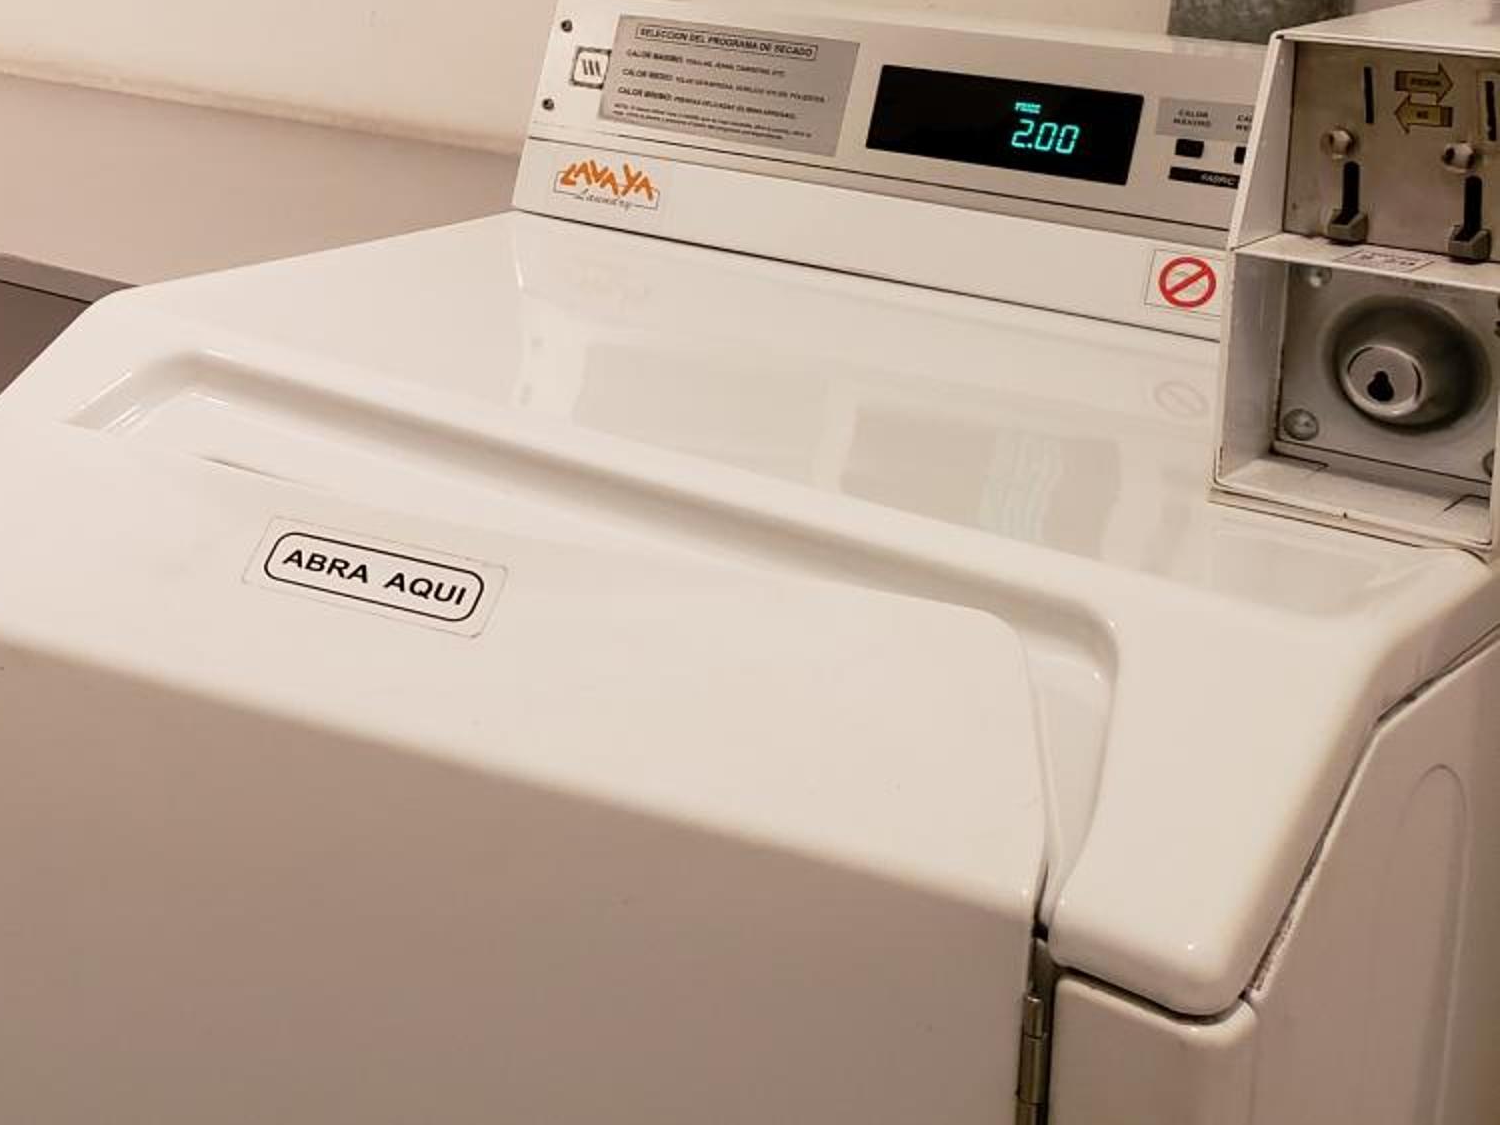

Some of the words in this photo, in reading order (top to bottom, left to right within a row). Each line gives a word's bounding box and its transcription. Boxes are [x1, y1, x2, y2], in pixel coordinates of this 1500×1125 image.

[689, 33, 706, 44] DEL
[707, 36, 757, 50] PROGRAMA
[773, 44, 813, 57] SECADO
[618, 86, 643, 97] CALOR
[1173, 118, 1211, 129] MAXIMO
[1178, 108, 1209, 119] CALOR
[1011, 118, 1080, 154] 2.00
[560, 159, 654, 200] LAVAYA
[282, 549, 368, 584] ABRA
[384, 572, 467, 606] AQUI
